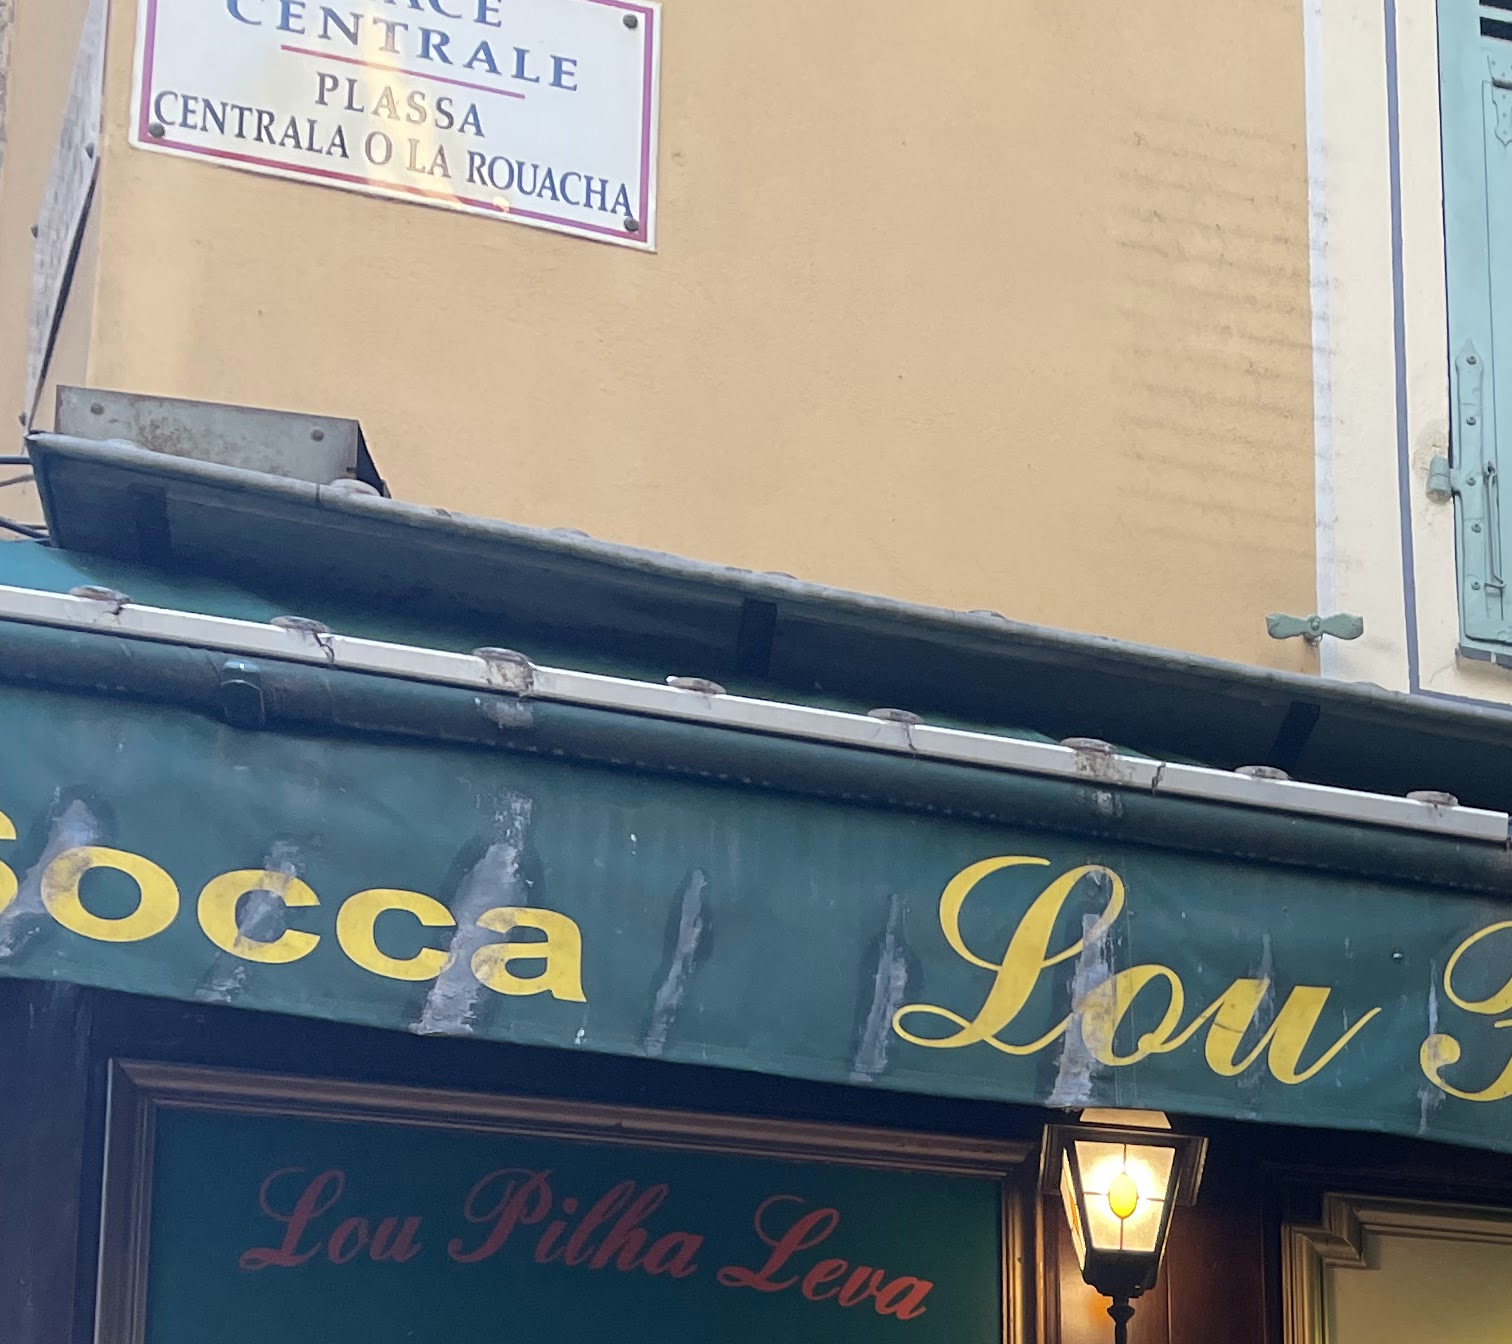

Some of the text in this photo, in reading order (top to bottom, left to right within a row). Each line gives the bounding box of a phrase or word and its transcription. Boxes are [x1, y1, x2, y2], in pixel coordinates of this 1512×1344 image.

[226, 0, 579, 92] CENTRALE
[314, 71, 486, 139] PLASSA
[153, 90, 636, 220] CENTRALA O LA ROUACHA
[893, 856, 1383, 1085] Lou
[238, 1166, 935, 1321] Lou Pilha Leva
